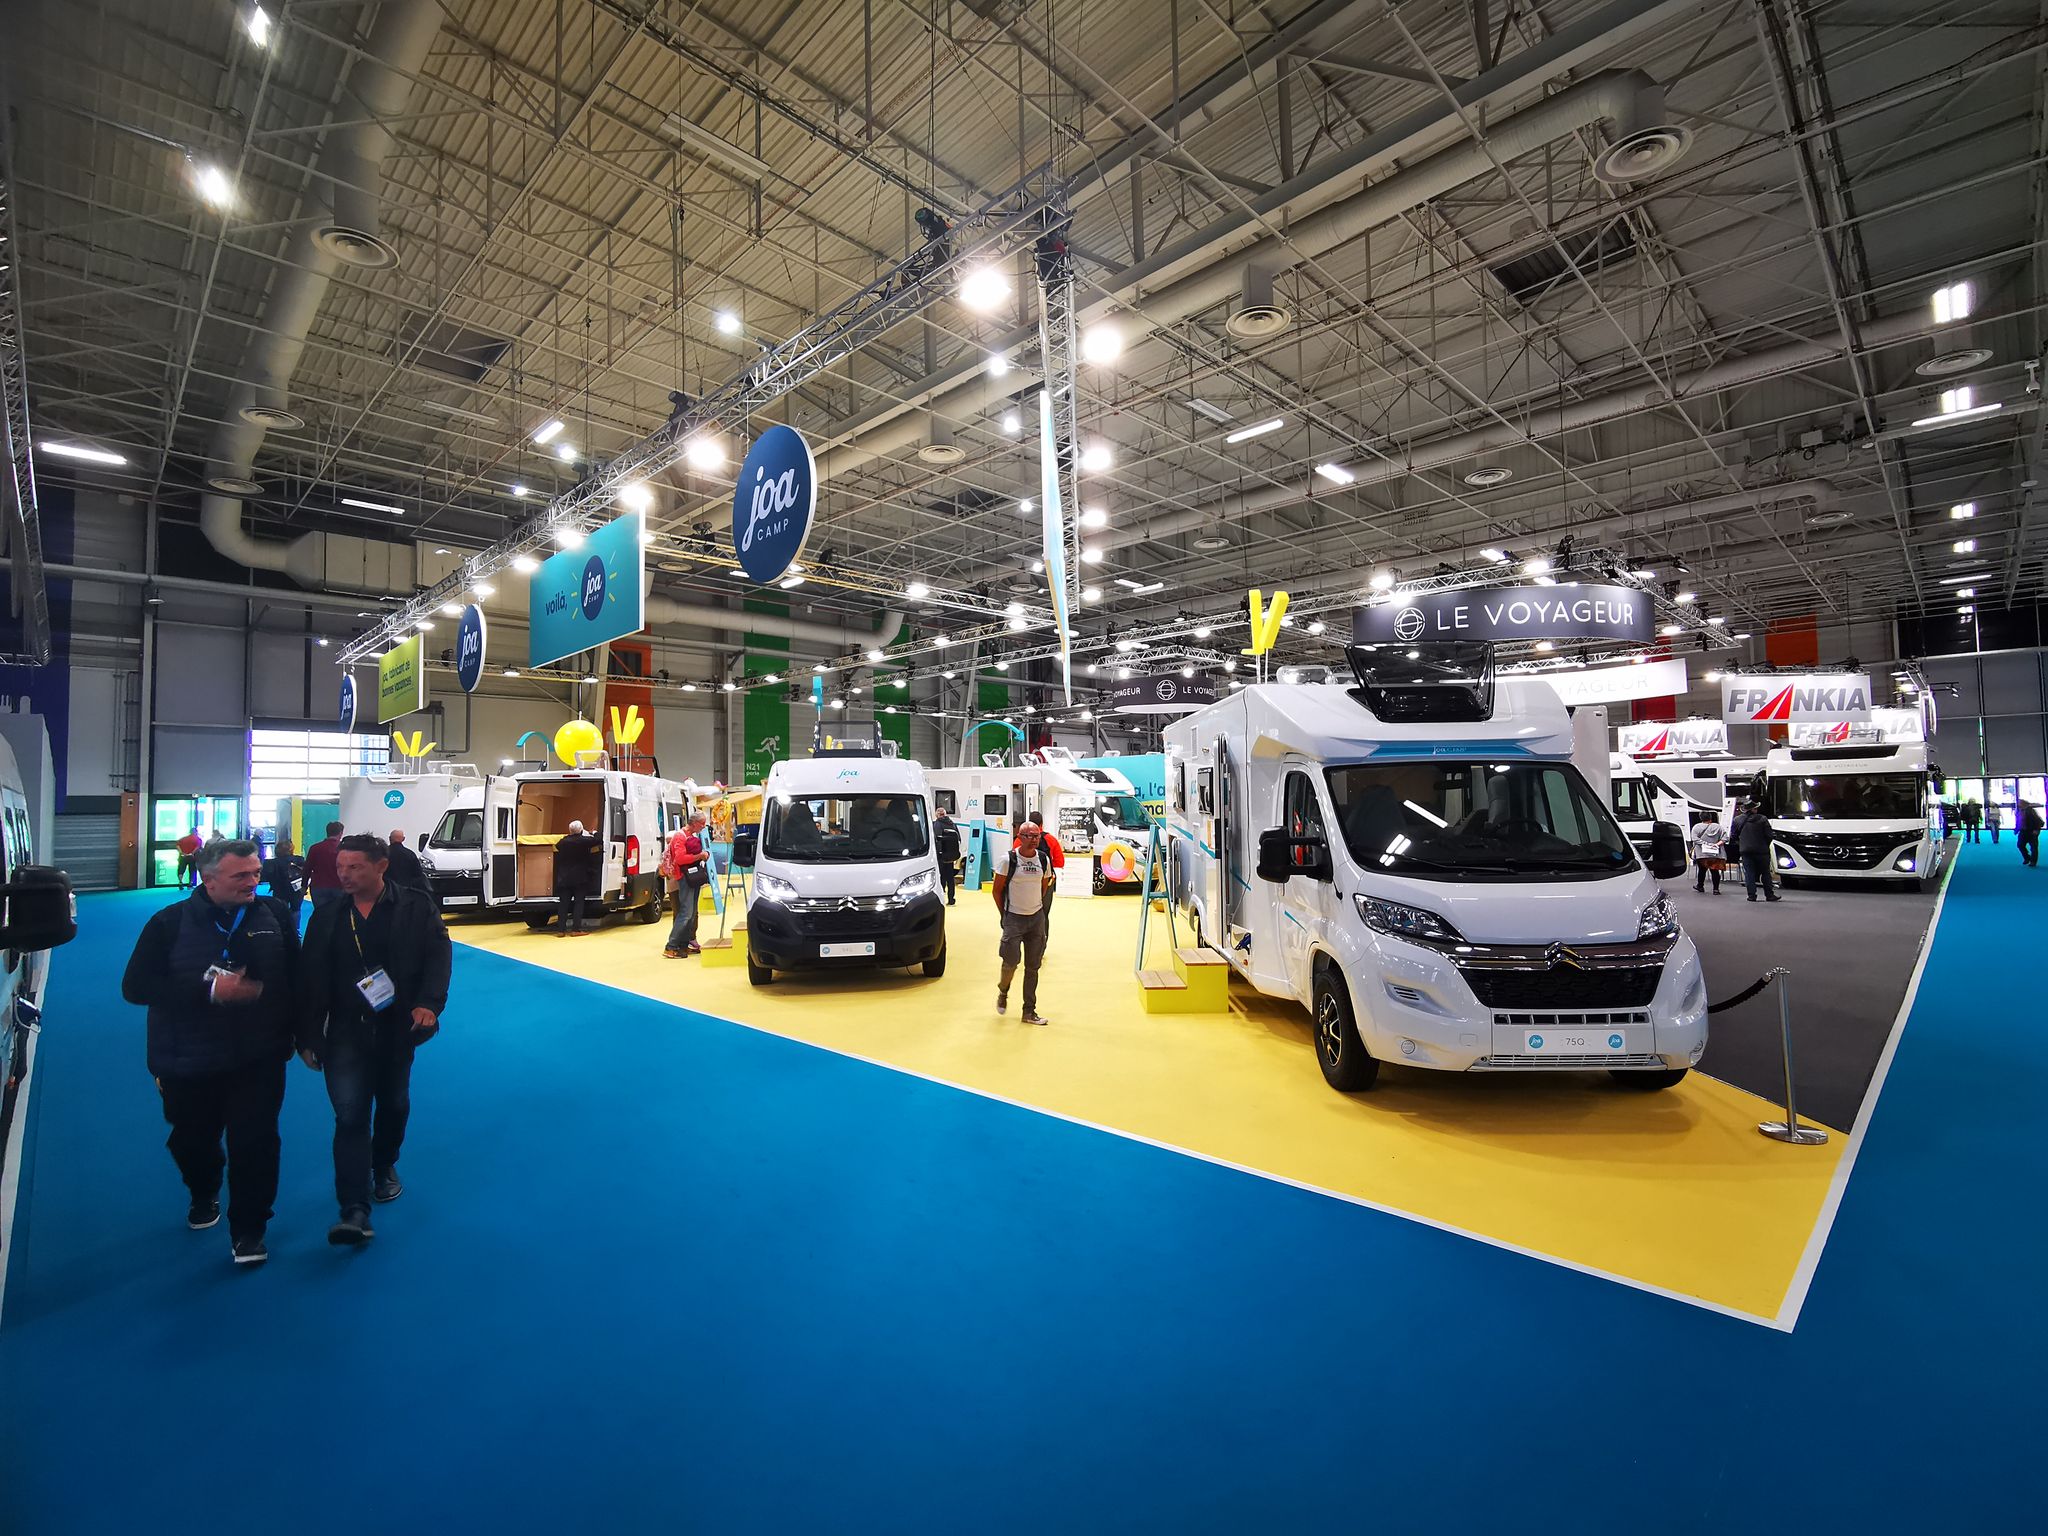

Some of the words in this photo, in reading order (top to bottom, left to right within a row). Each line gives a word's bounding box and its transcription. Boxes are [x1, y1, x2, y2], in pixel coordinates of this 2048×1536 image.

[742, 466, 799, 552] joa
[757, 518, 789, 541] CAMP
[584, 571, 602, 607] joa
[1437, 606, 1470, 631] LE
[1484, 600, 1634, 626] VOYAGEUR
[459, 624, 479, 672] joa
[1182, 686, 1192, 694] LE
[1728, 682, 1867, 720] FRANKIA
[340, 688, 352, 720] joa
[1622, 727, 1726, 751] FRANKIA
[746, 763, 760, 771] N21
[837, 768, 861, 779] joa
[386, 794, 402, 805] joa
[965, 796, 978, 811] joa
[1565, 1038, 1585, 1046] 75Q
